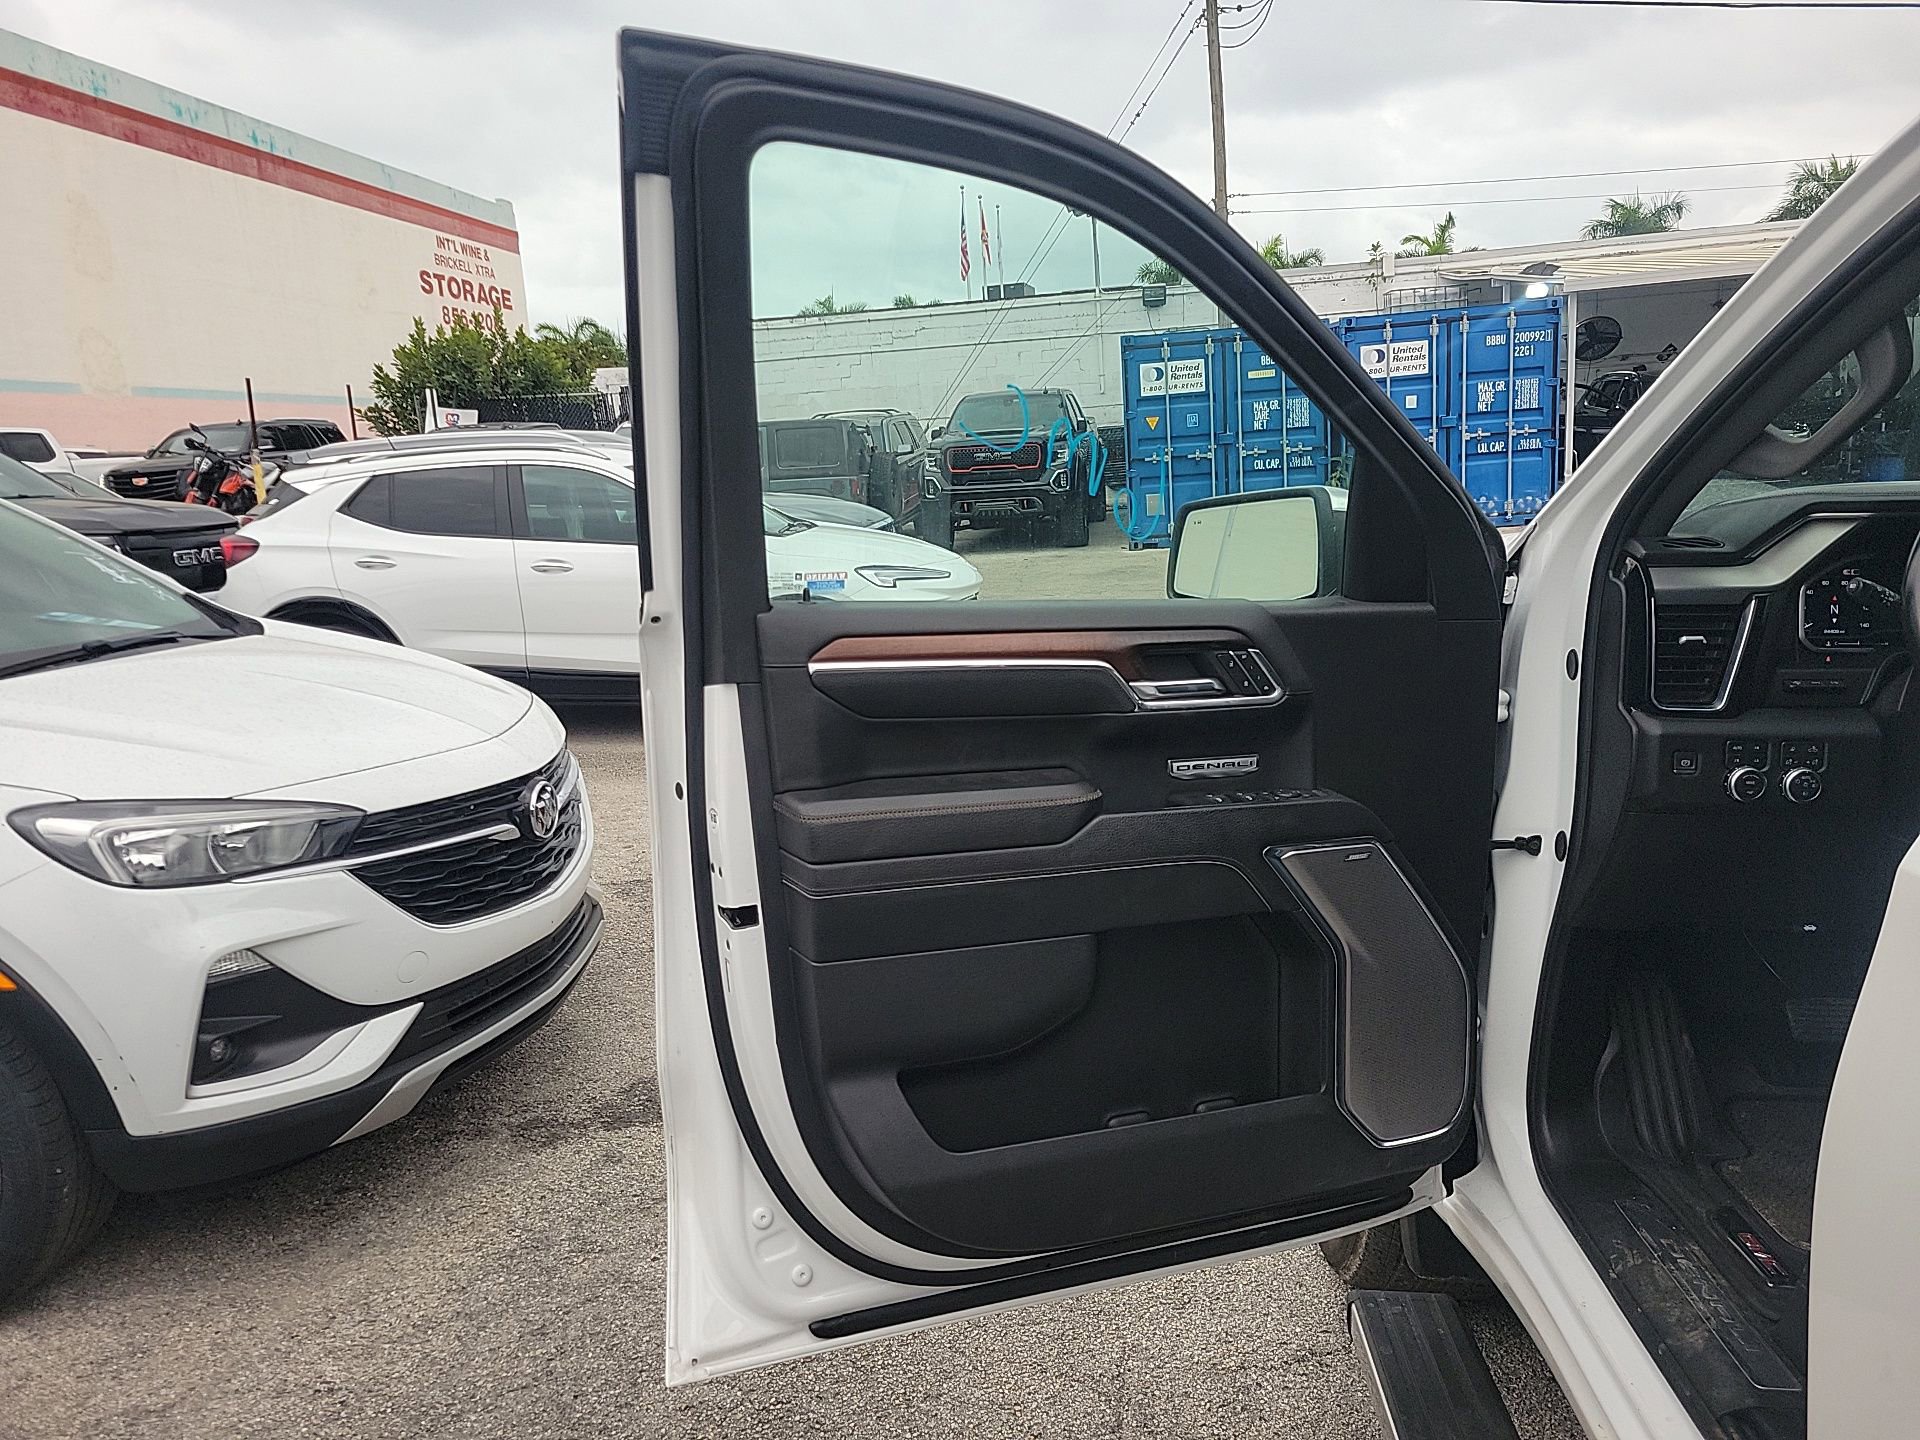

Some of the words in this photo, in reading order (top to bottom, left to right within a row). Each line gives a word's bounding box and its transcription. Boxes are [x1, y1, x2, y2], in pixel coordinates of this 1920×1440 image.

[436, 235, 459, 254] INT'L
[460, 242, 482, 260] WINE
[483, 249, 491, 262] &
[434, 253, 472, 274] BRICKELL
[475, 264, 496, 280] XTRA
[419, 270, 513, 310] STORAGE
[442, 306, 499, 332] 856-20
[1486, 334, 1506, 346] BBBU
[1392, 345, 1424, 355] United
[1514, 345, 1534, 357] 22G1
[1392, 353, 1427, 363] Rentals
[1170, 363, 1200, 373] United
[1170, 371, 1203, 381] Rentals
[1478, 392, 1495, 401] TARE
[1477, 401, 1492, 412] NET
[1254, 410, 1270, 420] TARE
[1253, 420, 1267, 430] NET
[974, 451, 1012, 461] GMC
[173, 546, 225, 567] GMC
[1830, 604, 1839, 615] N
[1175, 760, 1253, 773] DENALI
